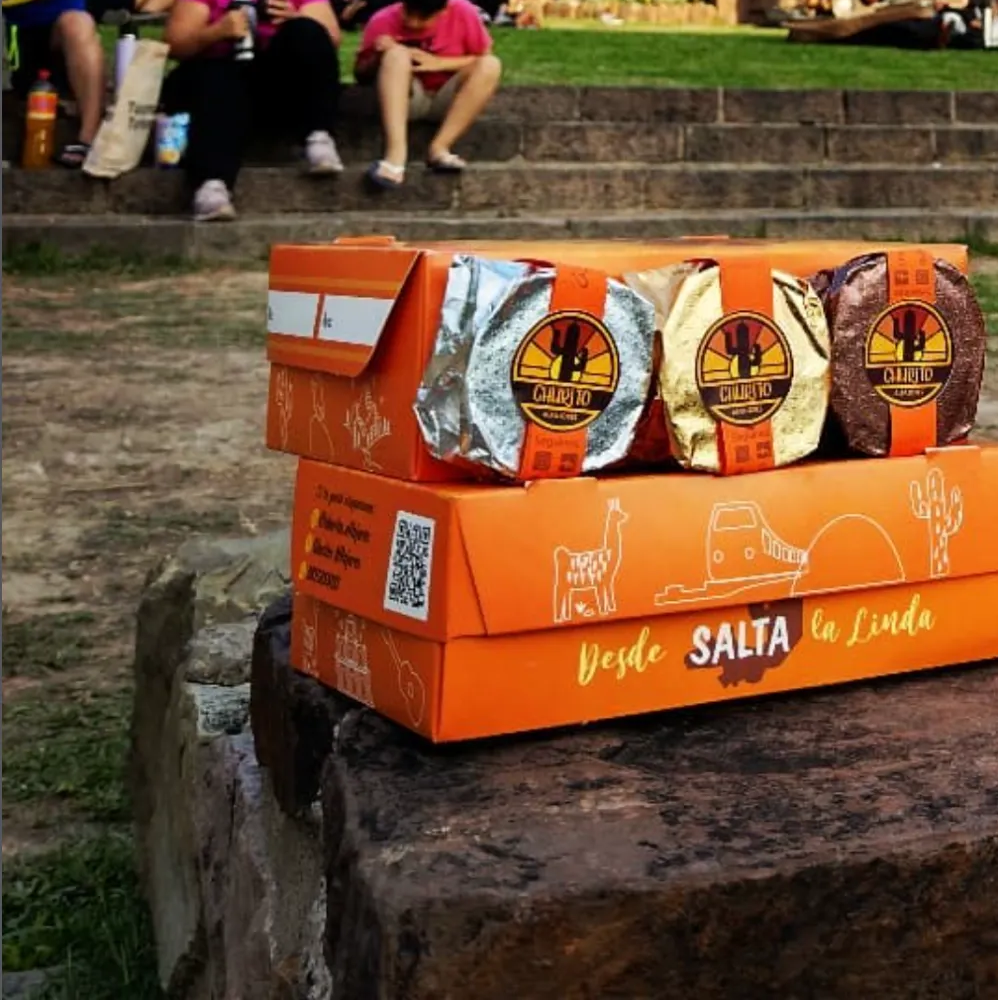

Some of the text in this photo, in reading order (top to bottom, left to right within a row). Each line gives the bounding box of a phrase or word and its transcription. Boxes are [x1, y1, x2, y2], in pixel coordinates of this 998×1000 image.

[577, 593, 936, 686] Desde SALTA la Linda
